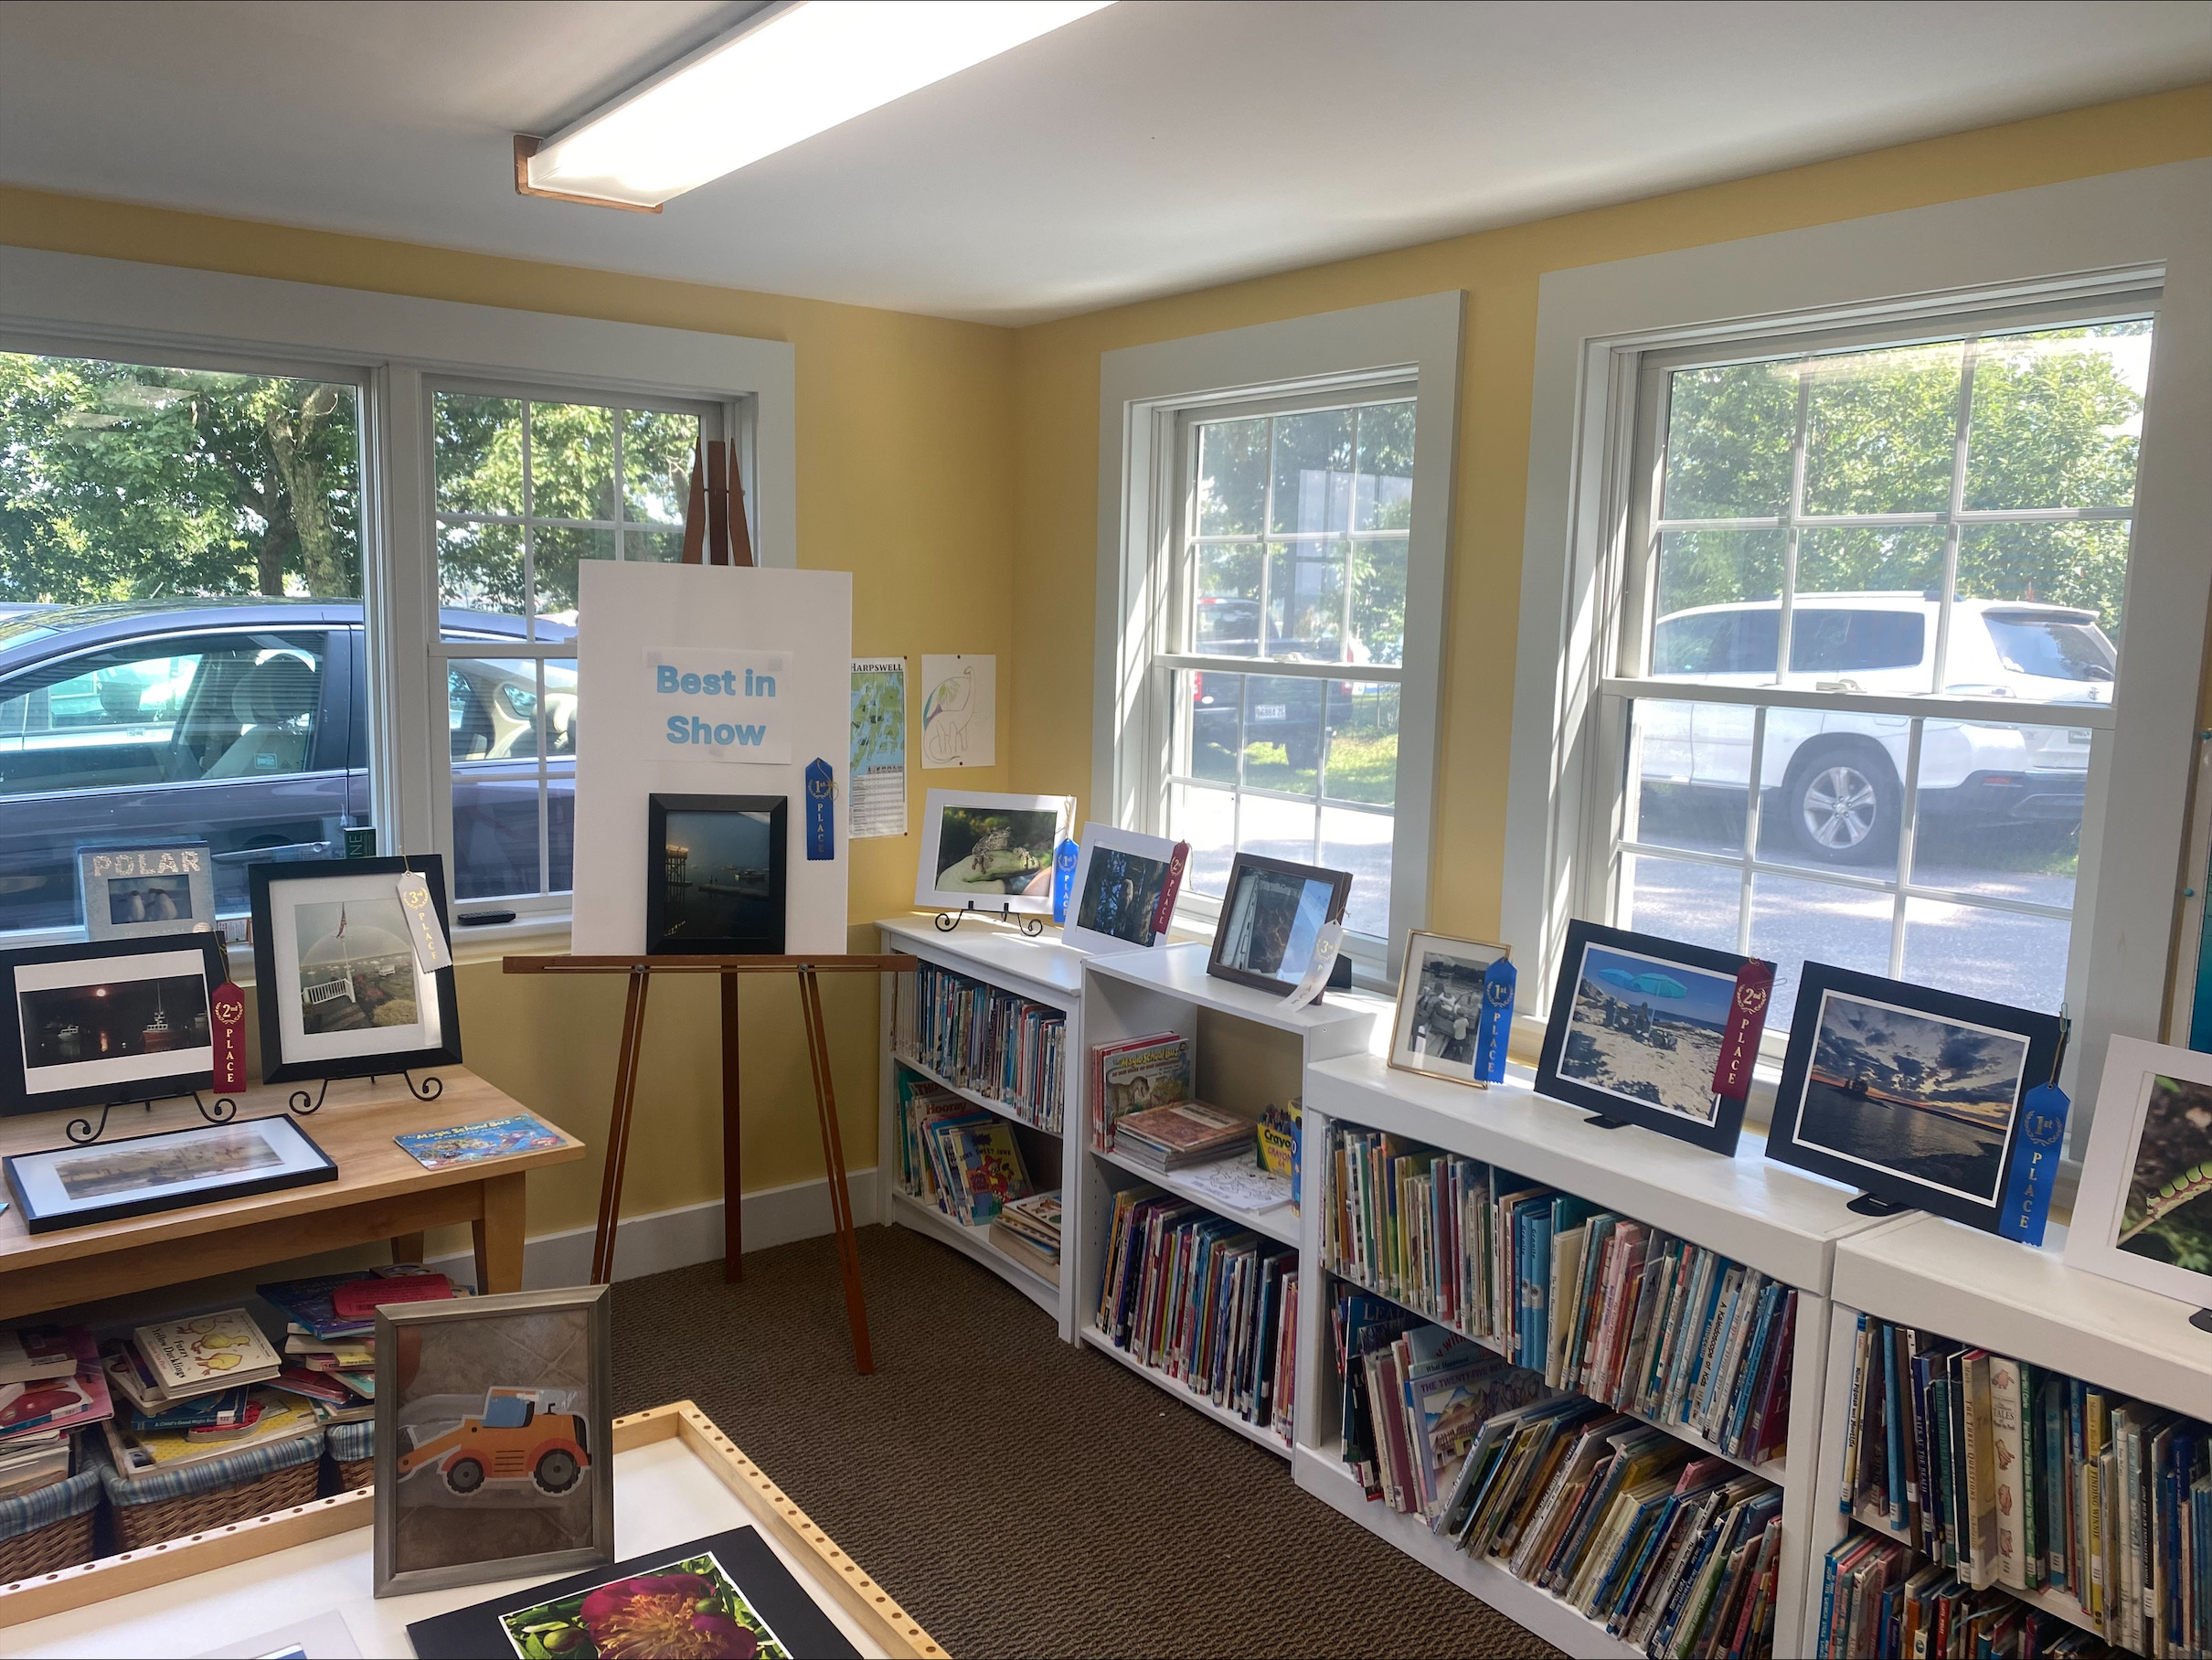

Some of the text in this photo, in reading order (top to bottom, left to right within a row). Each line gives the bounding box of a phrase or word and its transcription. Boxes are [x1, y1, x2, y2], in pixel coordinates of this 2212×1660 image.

[851, 663, 903, 672] HARPSWELL
[656, 665, 776, 697] Best in
[666, 716, 766, 746] Show
[817, 803, 825, 853] PLACE
[93, 851, 201, 878] POLAR
[1063, 856, 1072, 867] 1st
[409, 891, 423, 903] 3rd
[1159, 879, 1175, 924] PLACE
[419, 912, 439, 960] PLACE
[1494, 984, 1507, 1000] 1st
[1743, 987, 1761, 1006] 2nd
[222, 1004, 238, 1017] 2nd
[1488, 1012, 1501, 1072] PLACE
[1728, 1018, 1749, 1084] PLACE
[226, 1028, 235, 1082] PLACE
[1121, 1056, 1142, 1068] Magic
[1143, 1049, 1164, 1063] School
[1164, 1048, 1179, 1059] Bus
[926, 1101, 966, 1114] Hooray
[416, 1119, 512, 1140] Magic School Bus
[2035, 1115, 2054, 1136] 1st
[1264, 1129, 1291, 1148] Crayo
[1268, 1146, 1291, 1162] CRAYON
[2019, 1152, 2043, 1229] PLACE
[1706, 1310, 1725, 1358] Kaleidoscope
[152, 1327, 186, 1378] Yellow Ducklings
[175, 1339, 188, 1358] Fuzzy
[1704, 1361, 1712, 1369] of
[1420, 1380, 1438, 1393] THE
[1699, 1371, 1709, 1387] Kids
[1993, 1409, 2015, 1421] TALES
[1966, 1452, 1976, 1500] QUESTIONS
[2090, 1470, 2100, 1539] FINDING WINNIE
